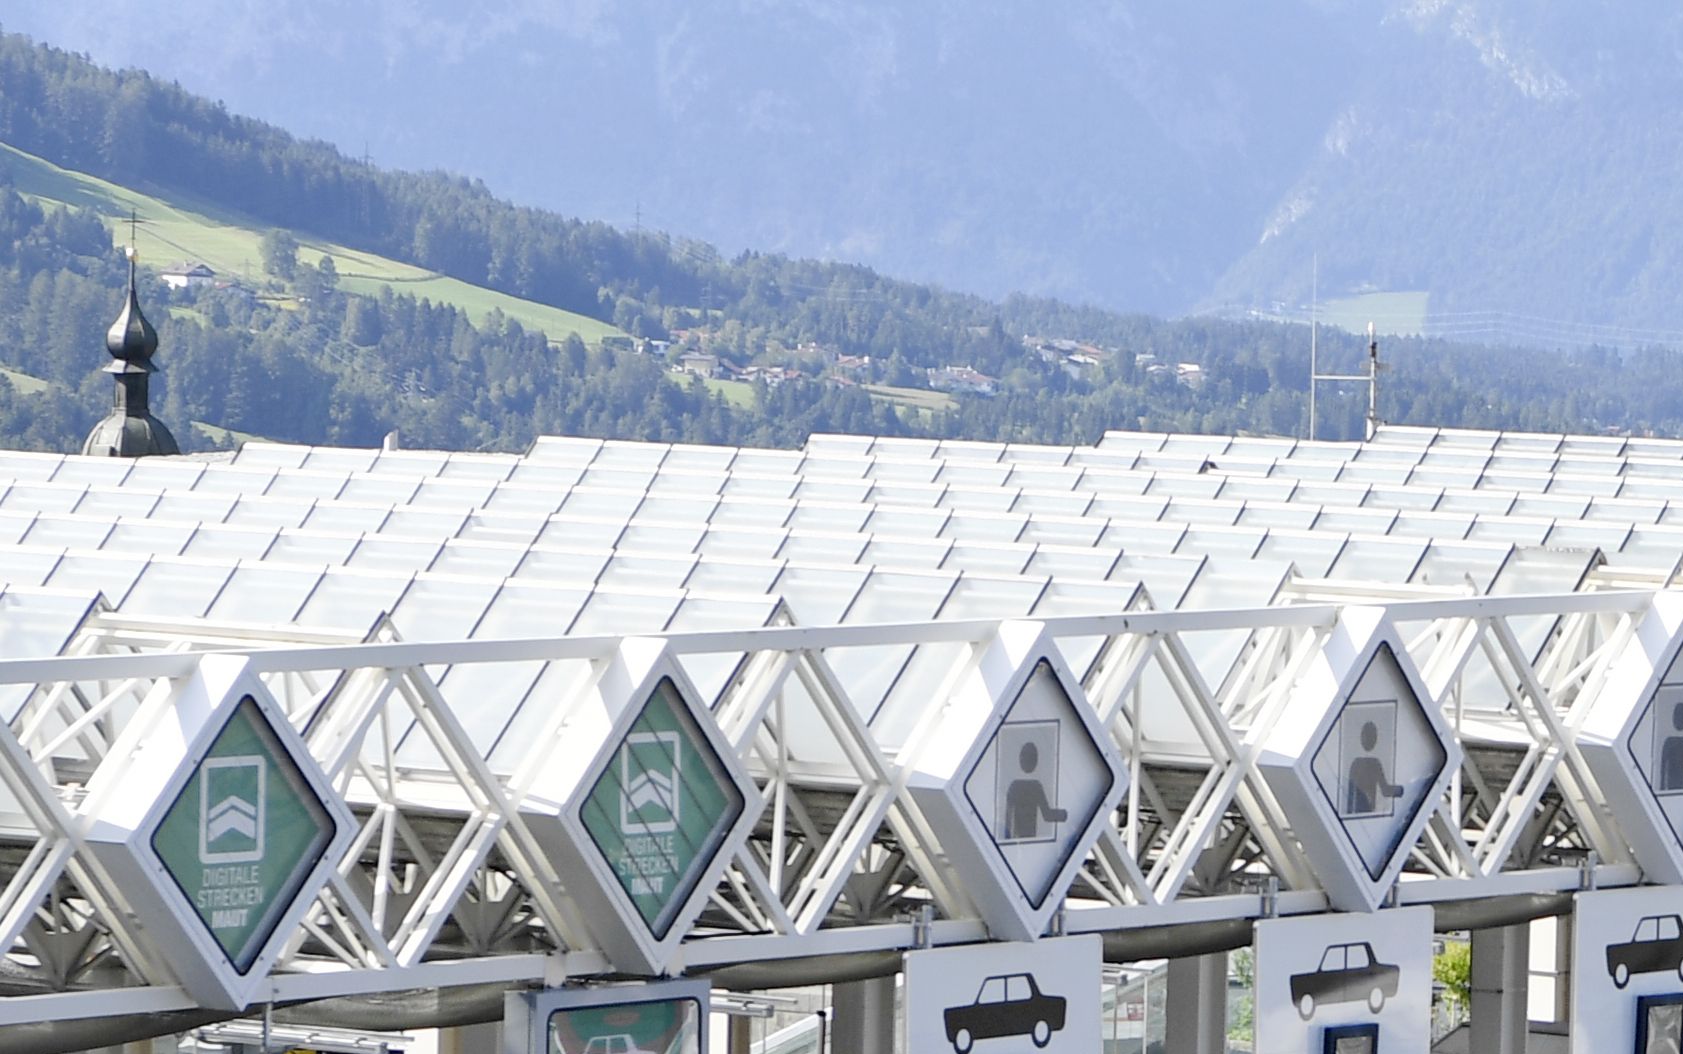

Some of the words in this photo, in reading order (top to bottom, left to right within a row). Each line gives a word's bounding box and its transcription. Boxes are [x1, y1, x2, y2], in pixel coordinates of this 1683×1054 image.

[203, 865, 259, 887] DIGITALE
[198, 886, 263, 909] STRECKEN
[212, 909, 248, 929] MAUT
